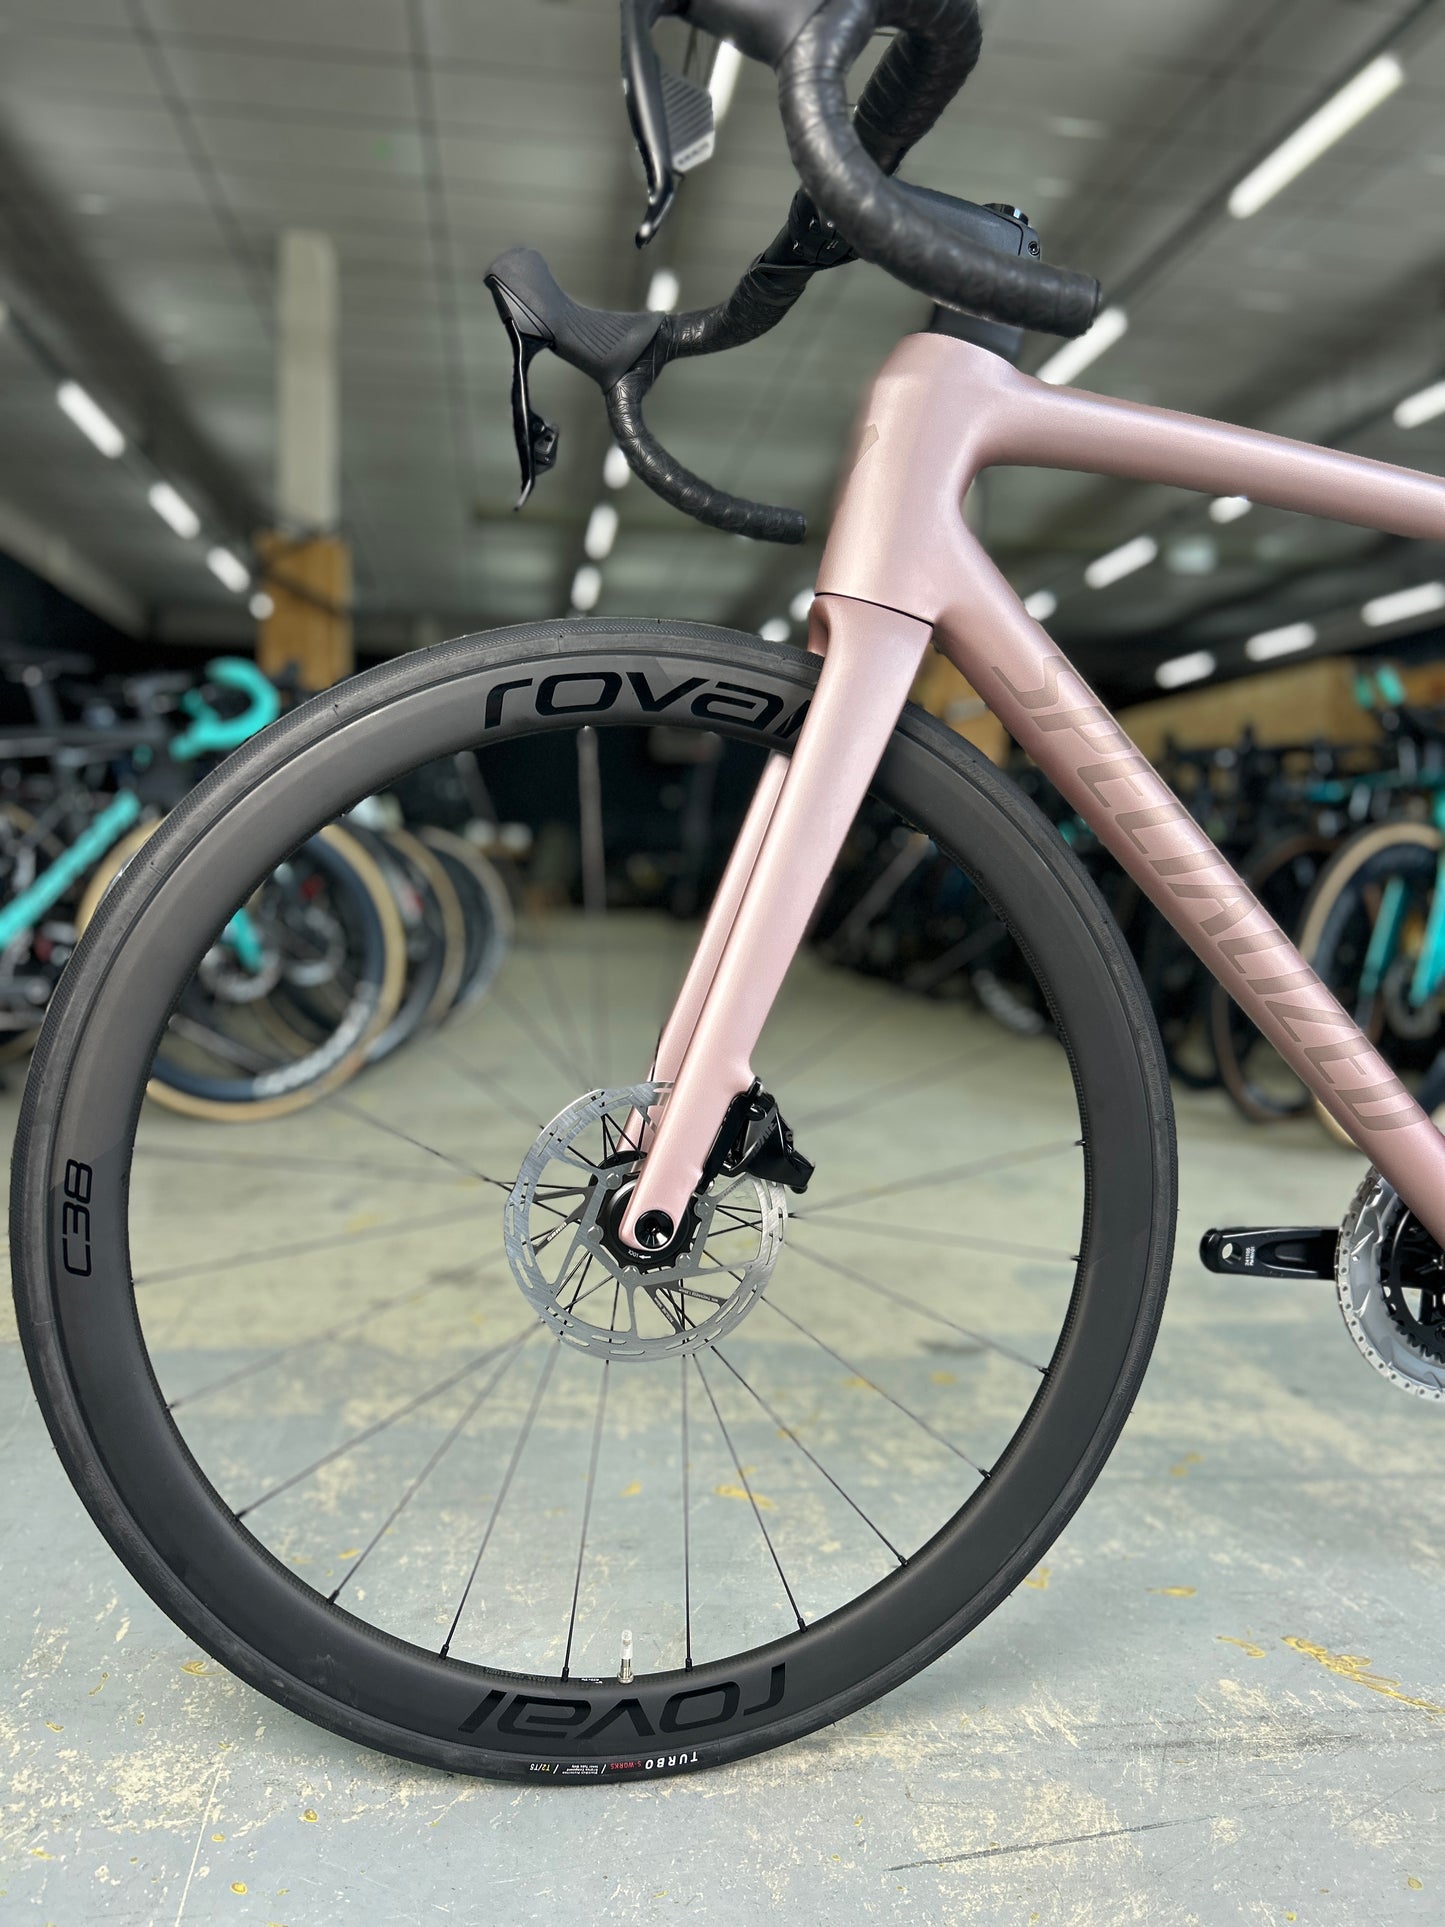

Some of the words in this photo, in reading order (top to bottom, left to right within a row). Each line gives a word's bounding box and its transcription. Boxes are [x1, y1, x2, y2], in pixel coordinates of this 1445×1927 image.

[990, 655, 1429, 1132] SPECIALIZED
[62, 1158, 93, 1277] C38
[458, 1662, 786, 1740] roval
[645, 1751, 698, 1770] TURBO
